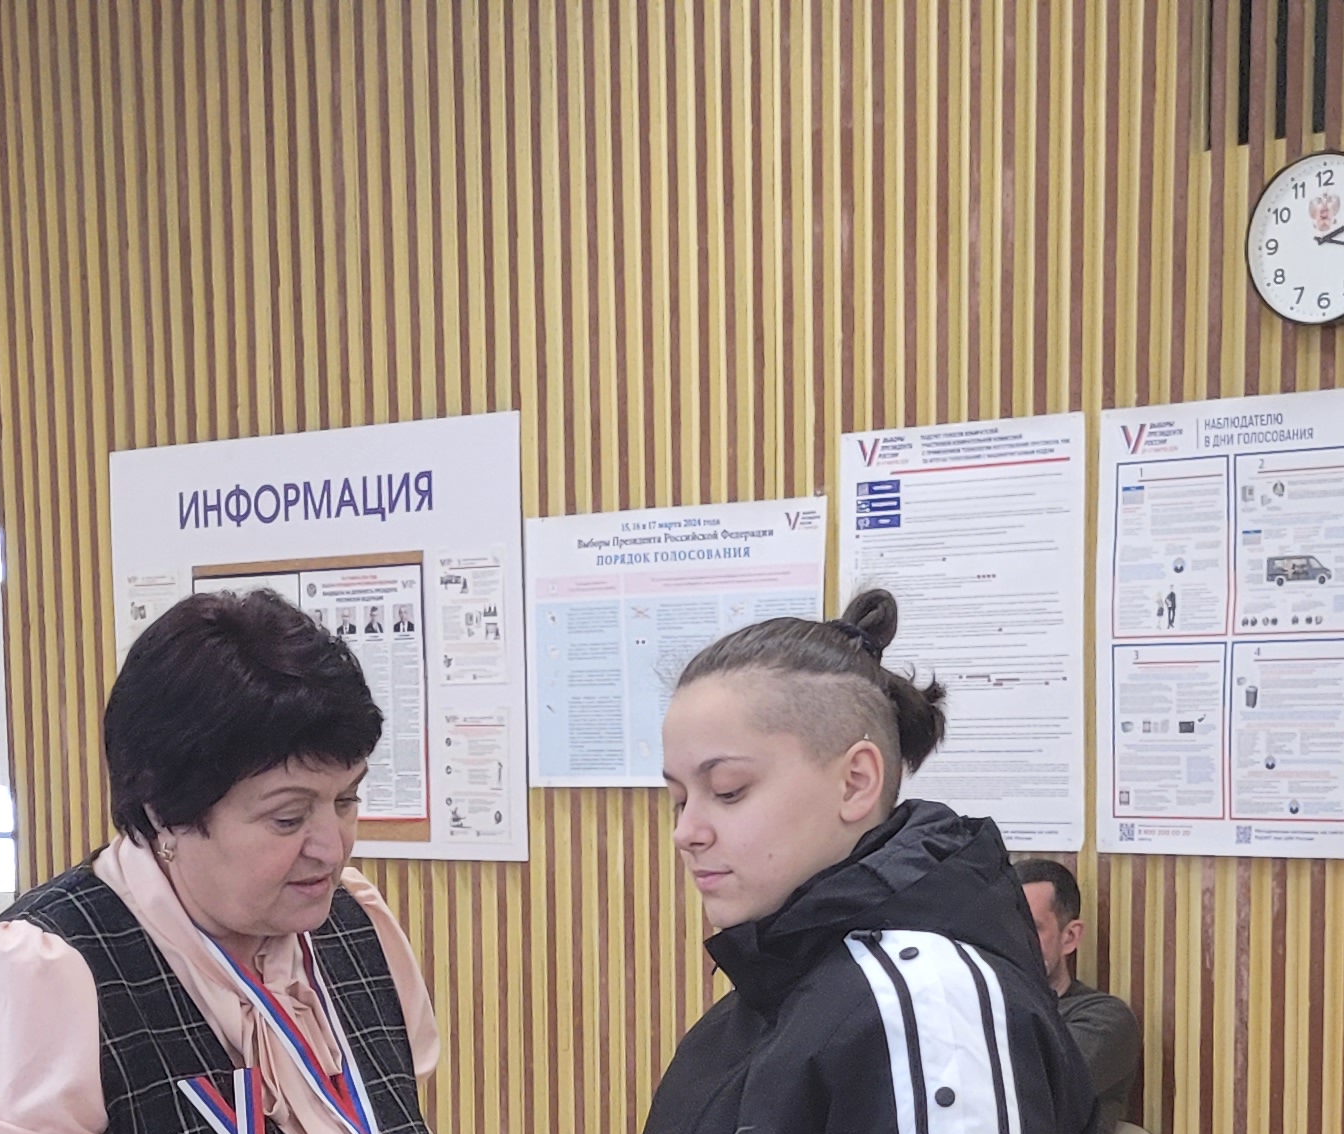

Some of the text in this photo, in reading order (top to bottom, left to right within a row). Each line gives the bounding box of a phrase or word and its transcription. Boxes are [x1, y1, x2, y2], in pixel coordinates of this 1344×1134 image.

[1316, 169, 1335, 187] 12
[1292, 181, 1306, 199] 11
[1272, 207, 1291, 225] 10
[1265, 238, 1279, 255] 9
[1273, 268, 1286, 285] 8
[1293, 286, 1305, 304] 7
[1317, 292, 1331, 309] 6
[1204, 413, 1284, 431] НАБЛЮДАТЕЛЮ
[1204, 428, 1314, 448] В ДНИ ГОЛОСОВАНИЯ
[178, 470, 434, 529] ИНФОРМАЦИЯ
[684, 518, 701, 527] 2024
[596, 546, 751, 566] ПОРЯДОК ГОЛОСОВАНИЯ
